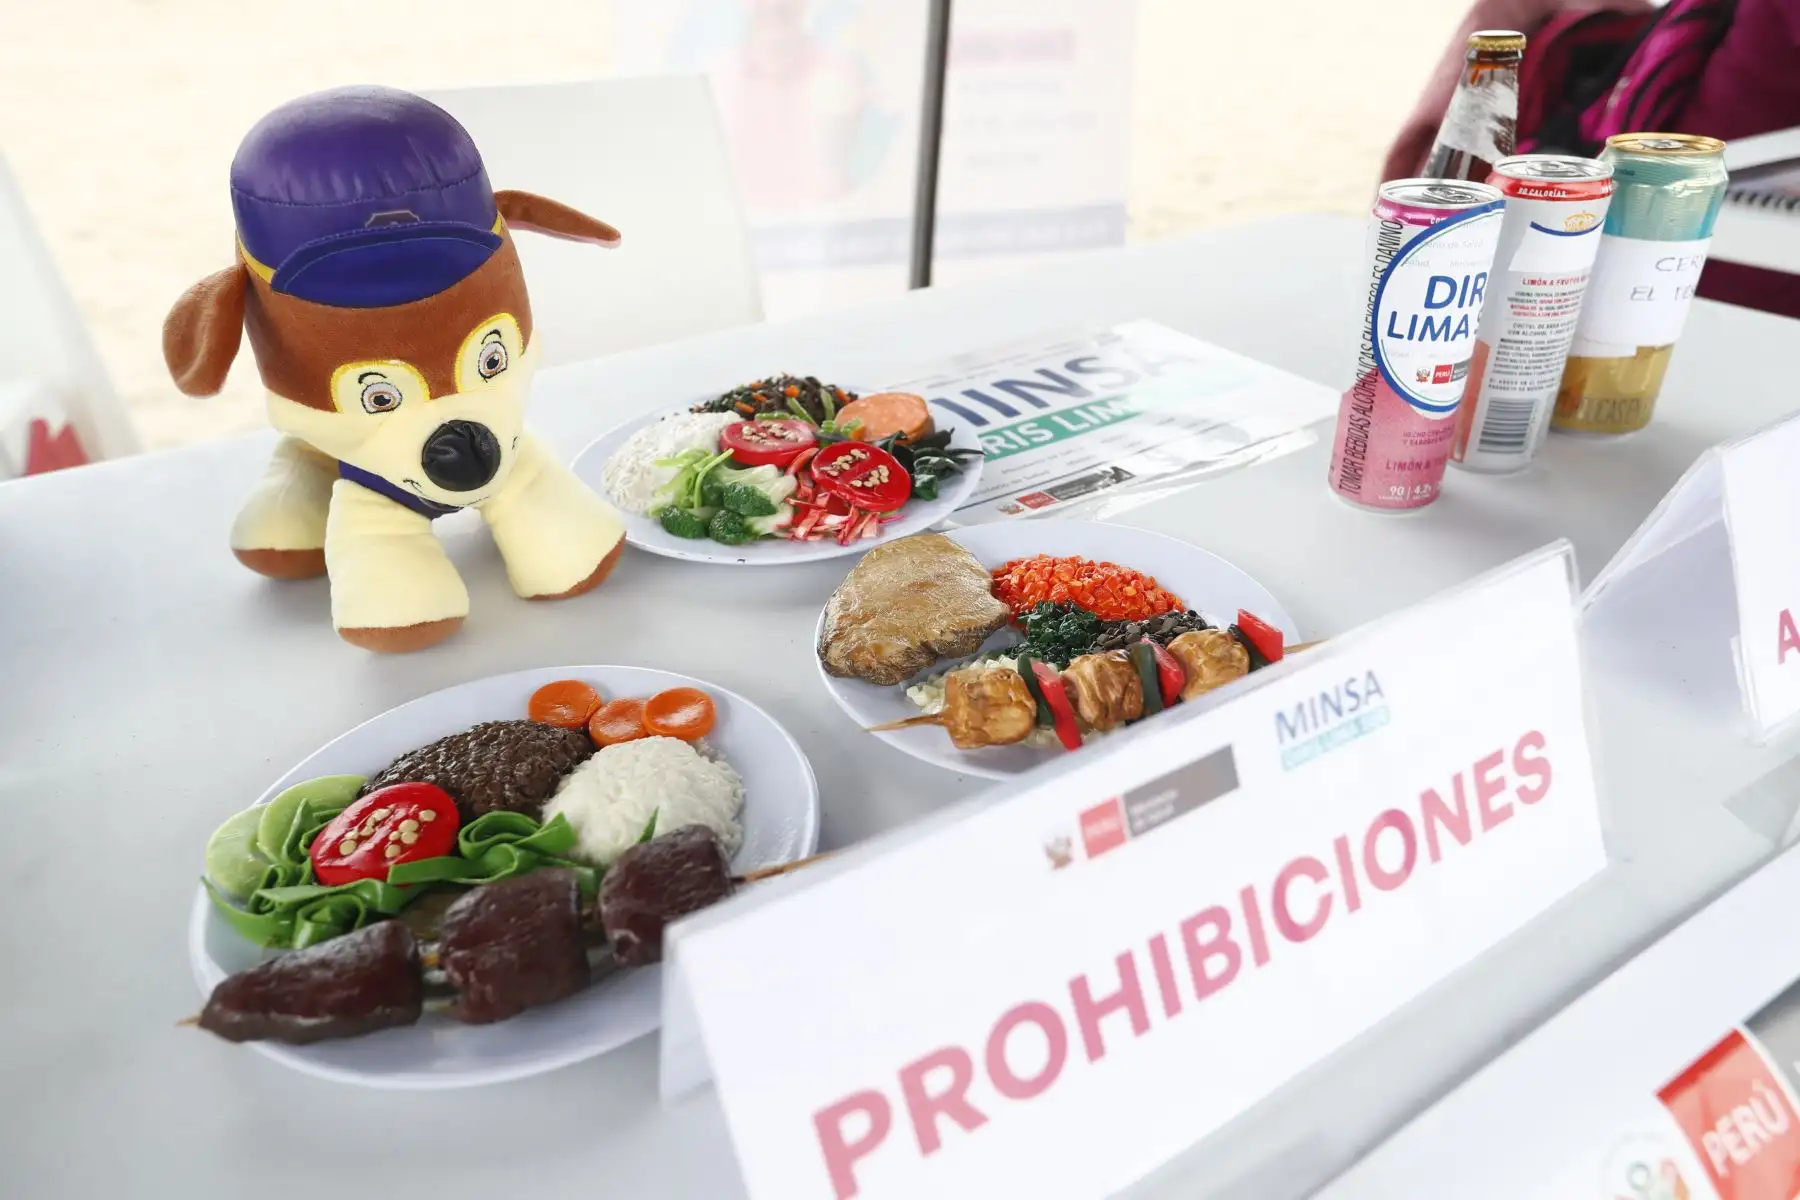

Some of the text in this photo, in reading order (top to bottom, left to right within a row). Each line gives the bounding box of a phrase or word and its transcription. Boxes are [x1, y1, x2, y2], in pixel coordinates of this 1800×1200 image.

[1387, 310, 1469, 342] LIMA
[1345, 413, 1371, 461] BEBIDAS
[1339, 457, 1365, 495] TOMAR
[1276, 670, 1386, 745] MINSA
[812, 730, 1554, 1200] PROHIBICIONES
[1702, 1077, 1790, 1177] PERÚ
